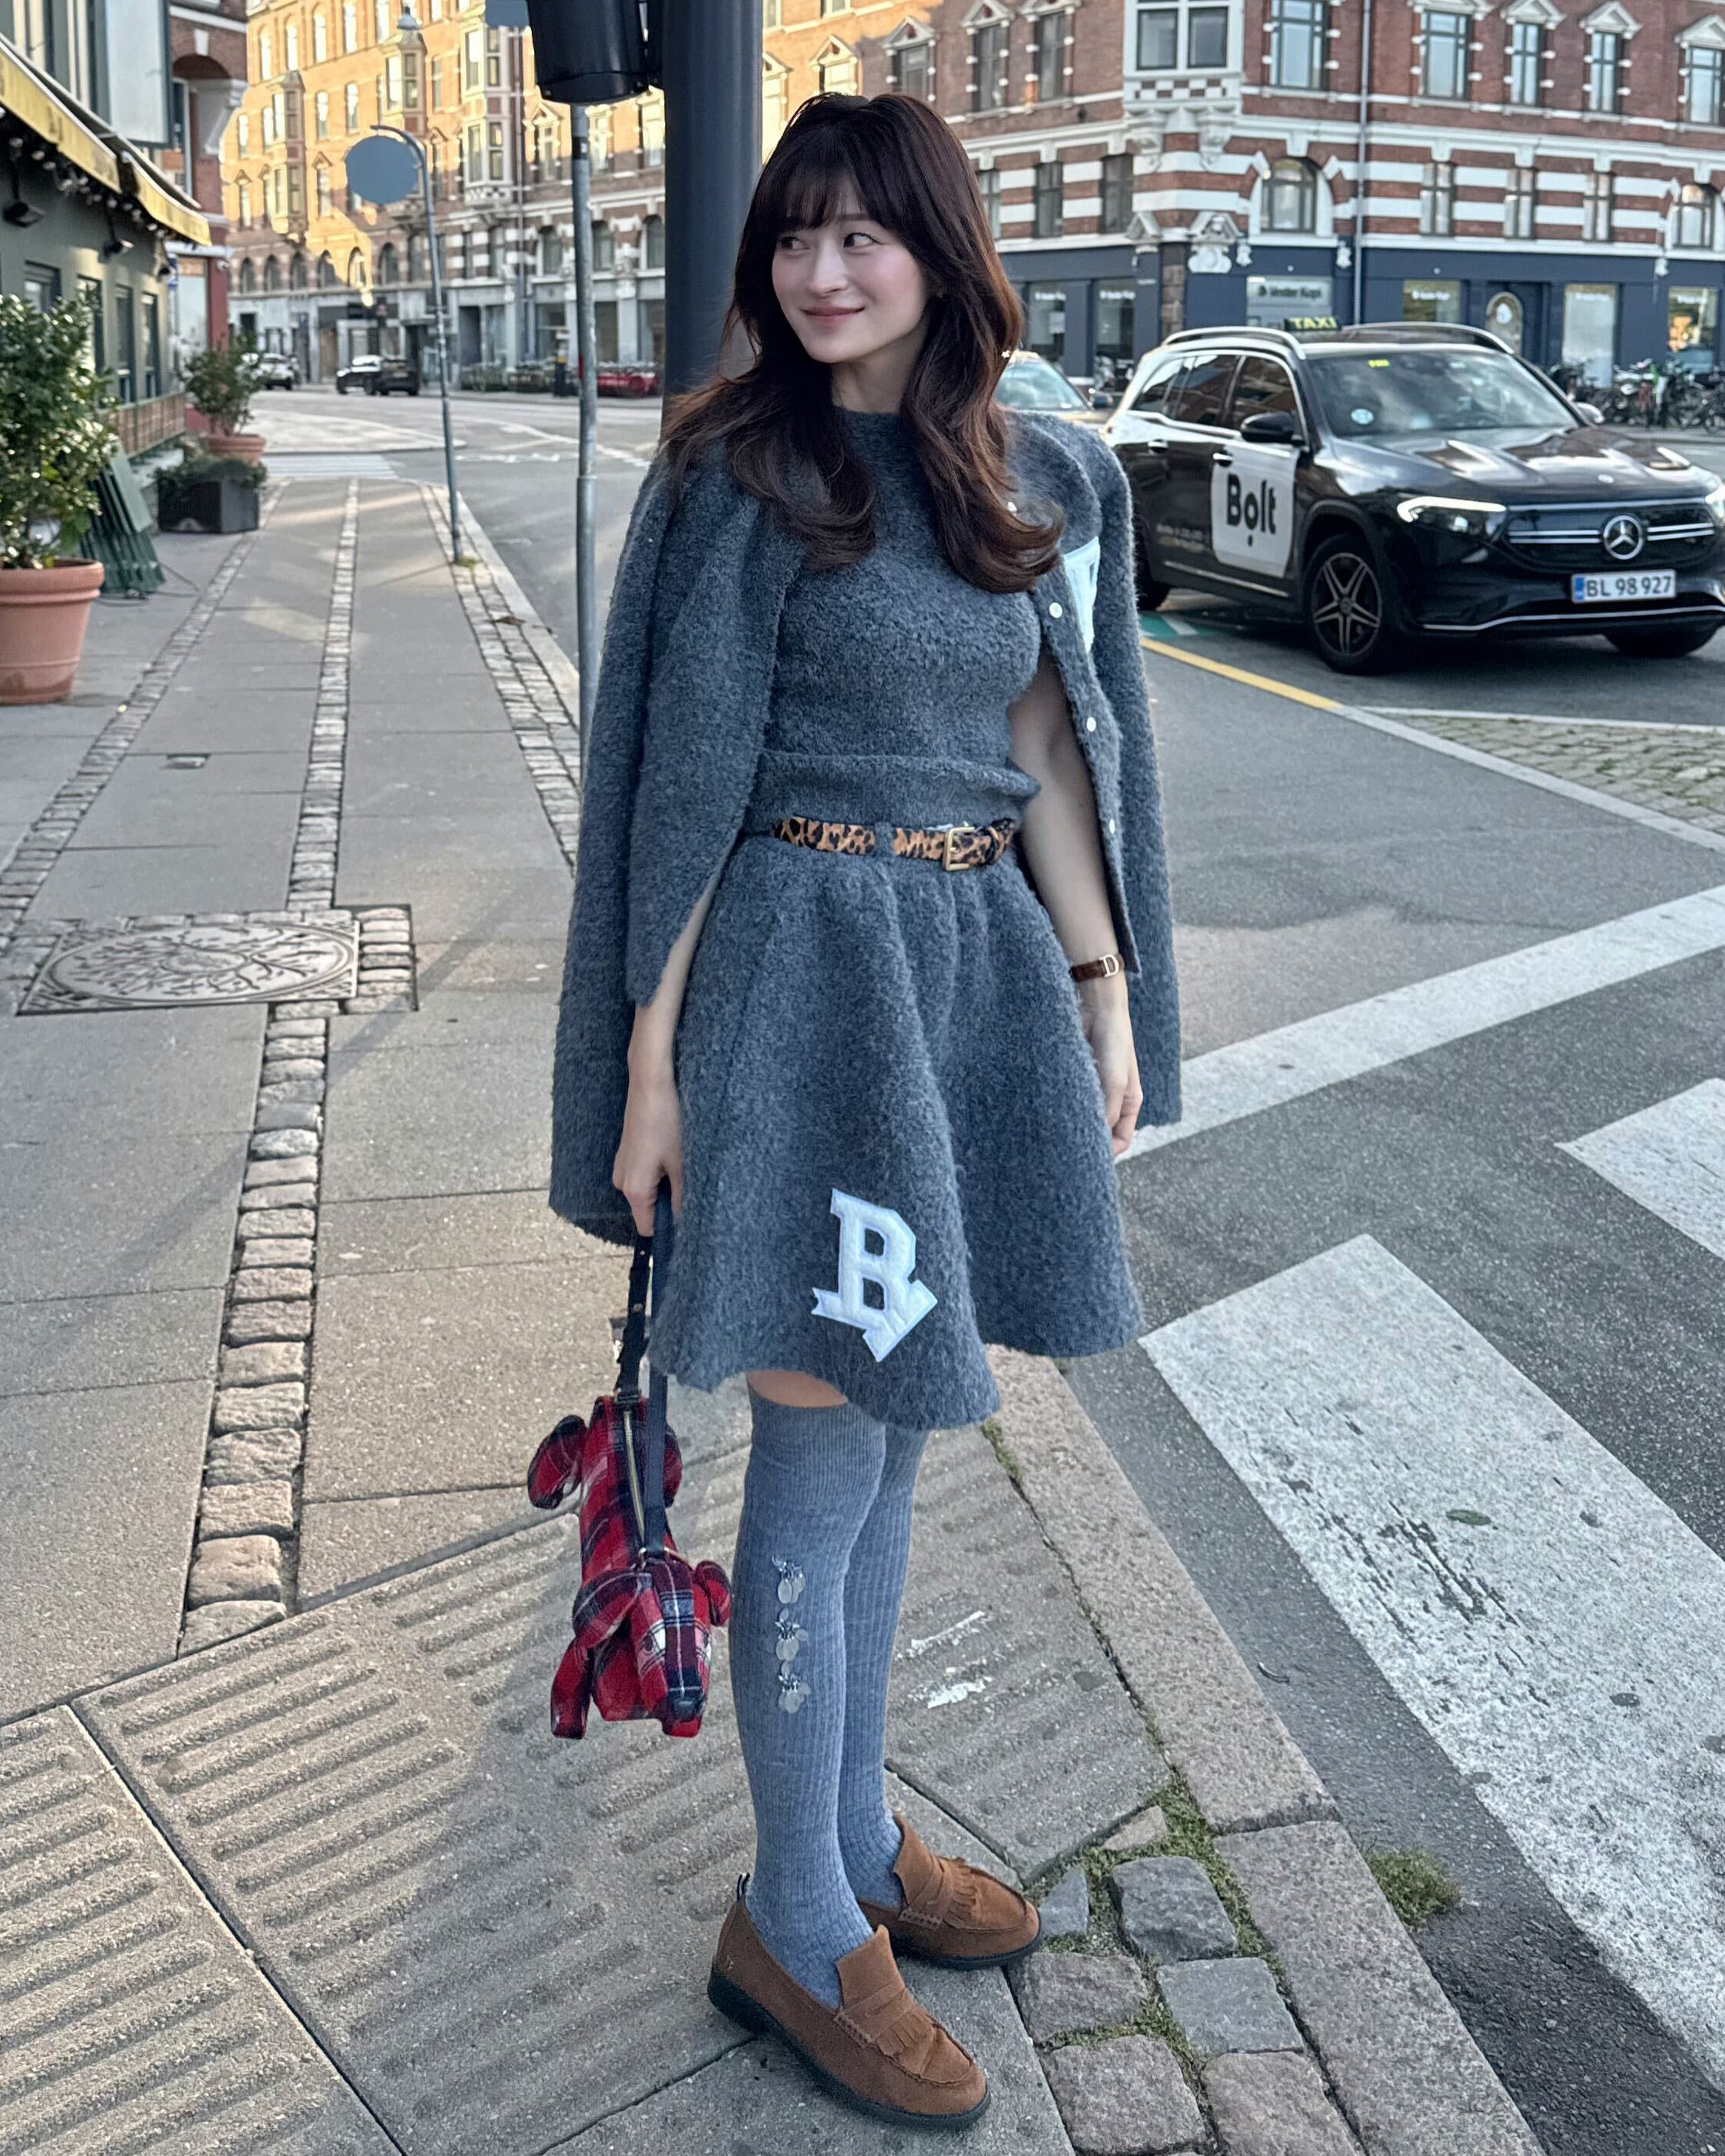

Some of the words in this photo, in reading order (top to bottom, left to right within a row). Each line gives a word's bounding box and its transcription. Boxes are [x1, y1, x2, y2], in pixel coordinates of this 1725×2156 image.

[1289, 317, 1337, 329] TAXI
[1226, 473, 1277, 547] Bolt
[1586, 579, 1611, 597] BL
[1616, 577, 1637, 595] 98
[1641, 576, 1672, 594] 927
